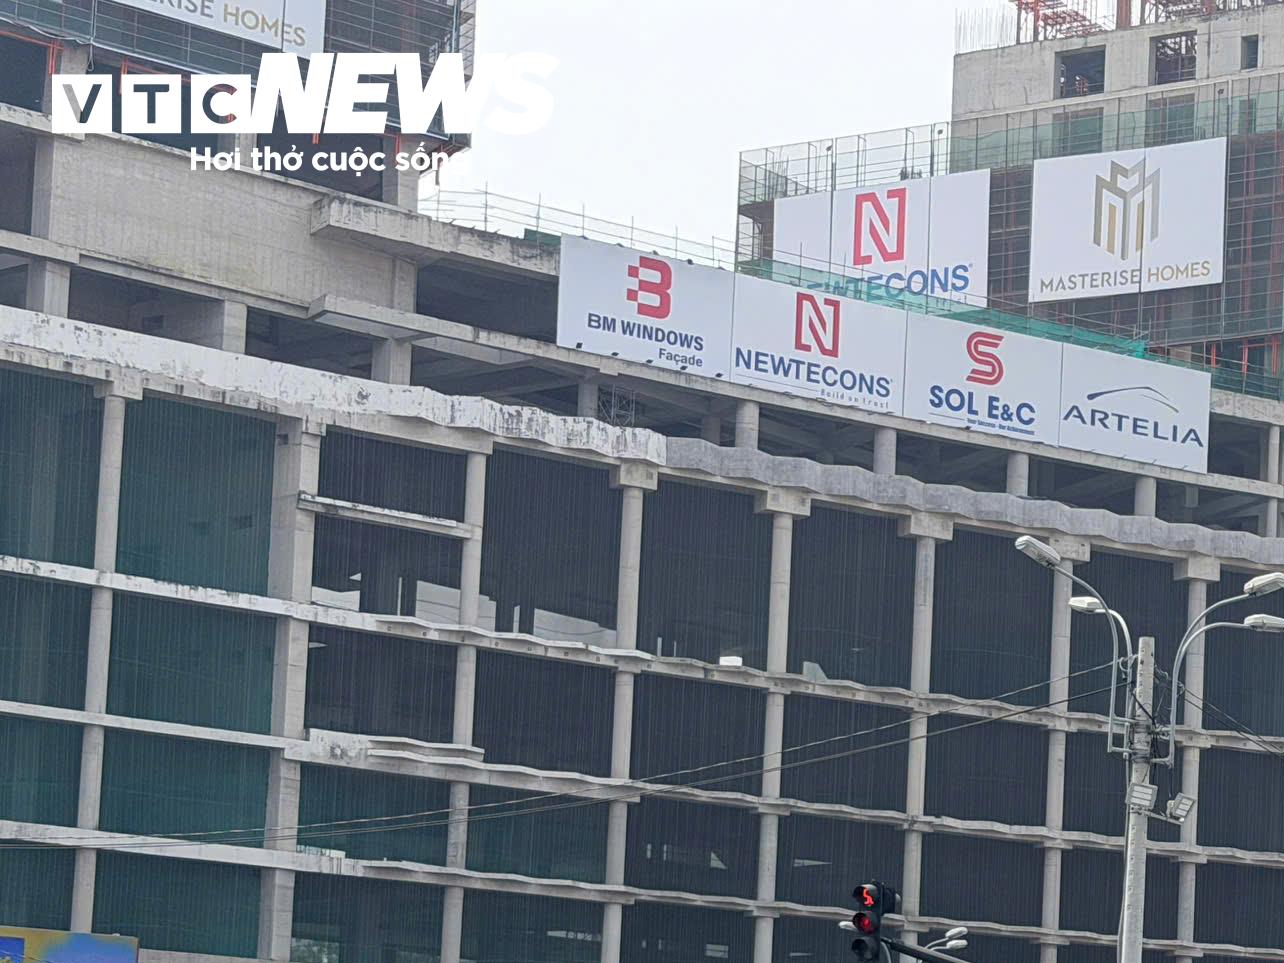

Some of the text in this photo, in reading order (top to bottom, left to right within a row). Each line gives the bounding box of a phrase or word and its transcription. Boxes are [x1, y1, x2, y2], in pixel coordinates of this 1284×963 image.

[223, 3, 306, 47] HOMES
[1039, 260, 1211, 293] MASTERISE HOMES
[587, 312, 704, 352] BM WINDOWS
[658, 347, 703, 367] Façade
[735, 346, 891, 399] NEWTECONS
[929, 385, 1036, 426] SOL E&C
[1062, 404, 1204, 448] ARTELIA
